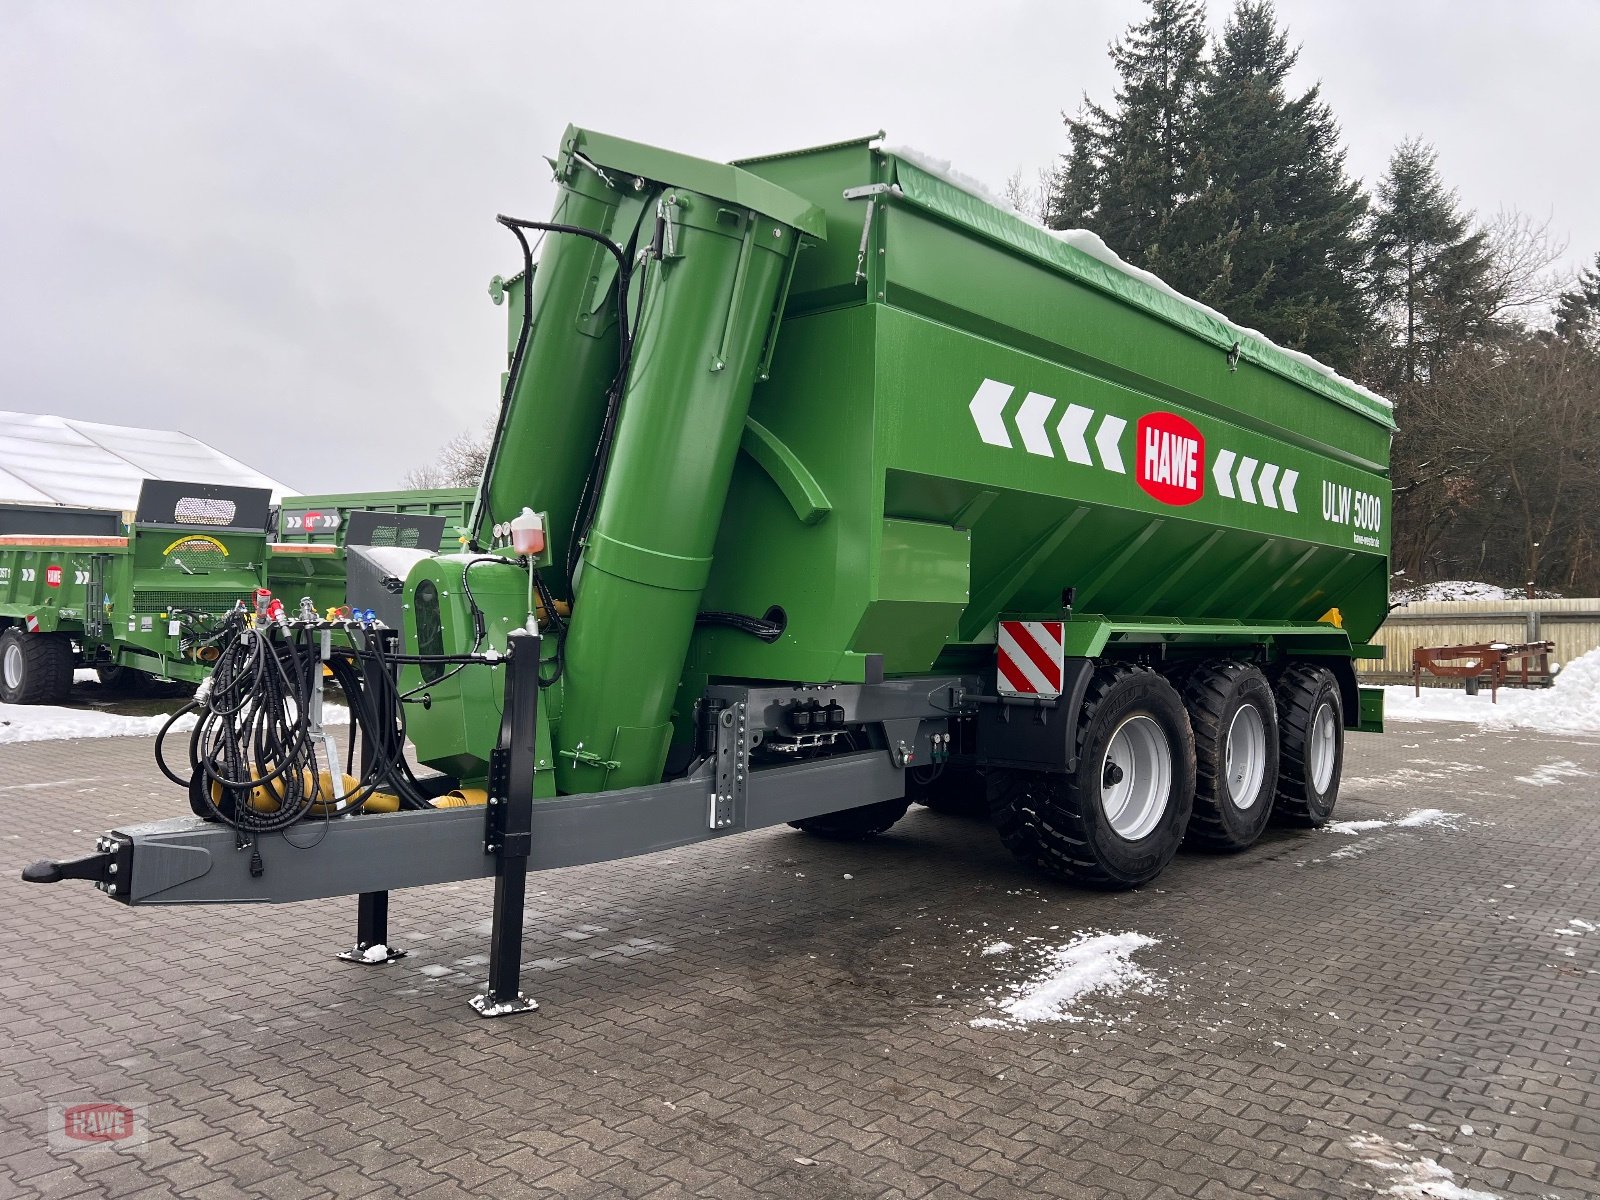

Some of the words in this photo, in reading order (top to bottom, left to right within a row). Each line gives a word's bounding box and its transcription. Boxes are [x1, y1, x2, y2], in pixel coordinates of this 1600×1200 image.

[1144, 426, 1198, 491] HAWE
[1322, 480, 1352, 525] ULW
[1353, 490, 1381, 533] 5000
